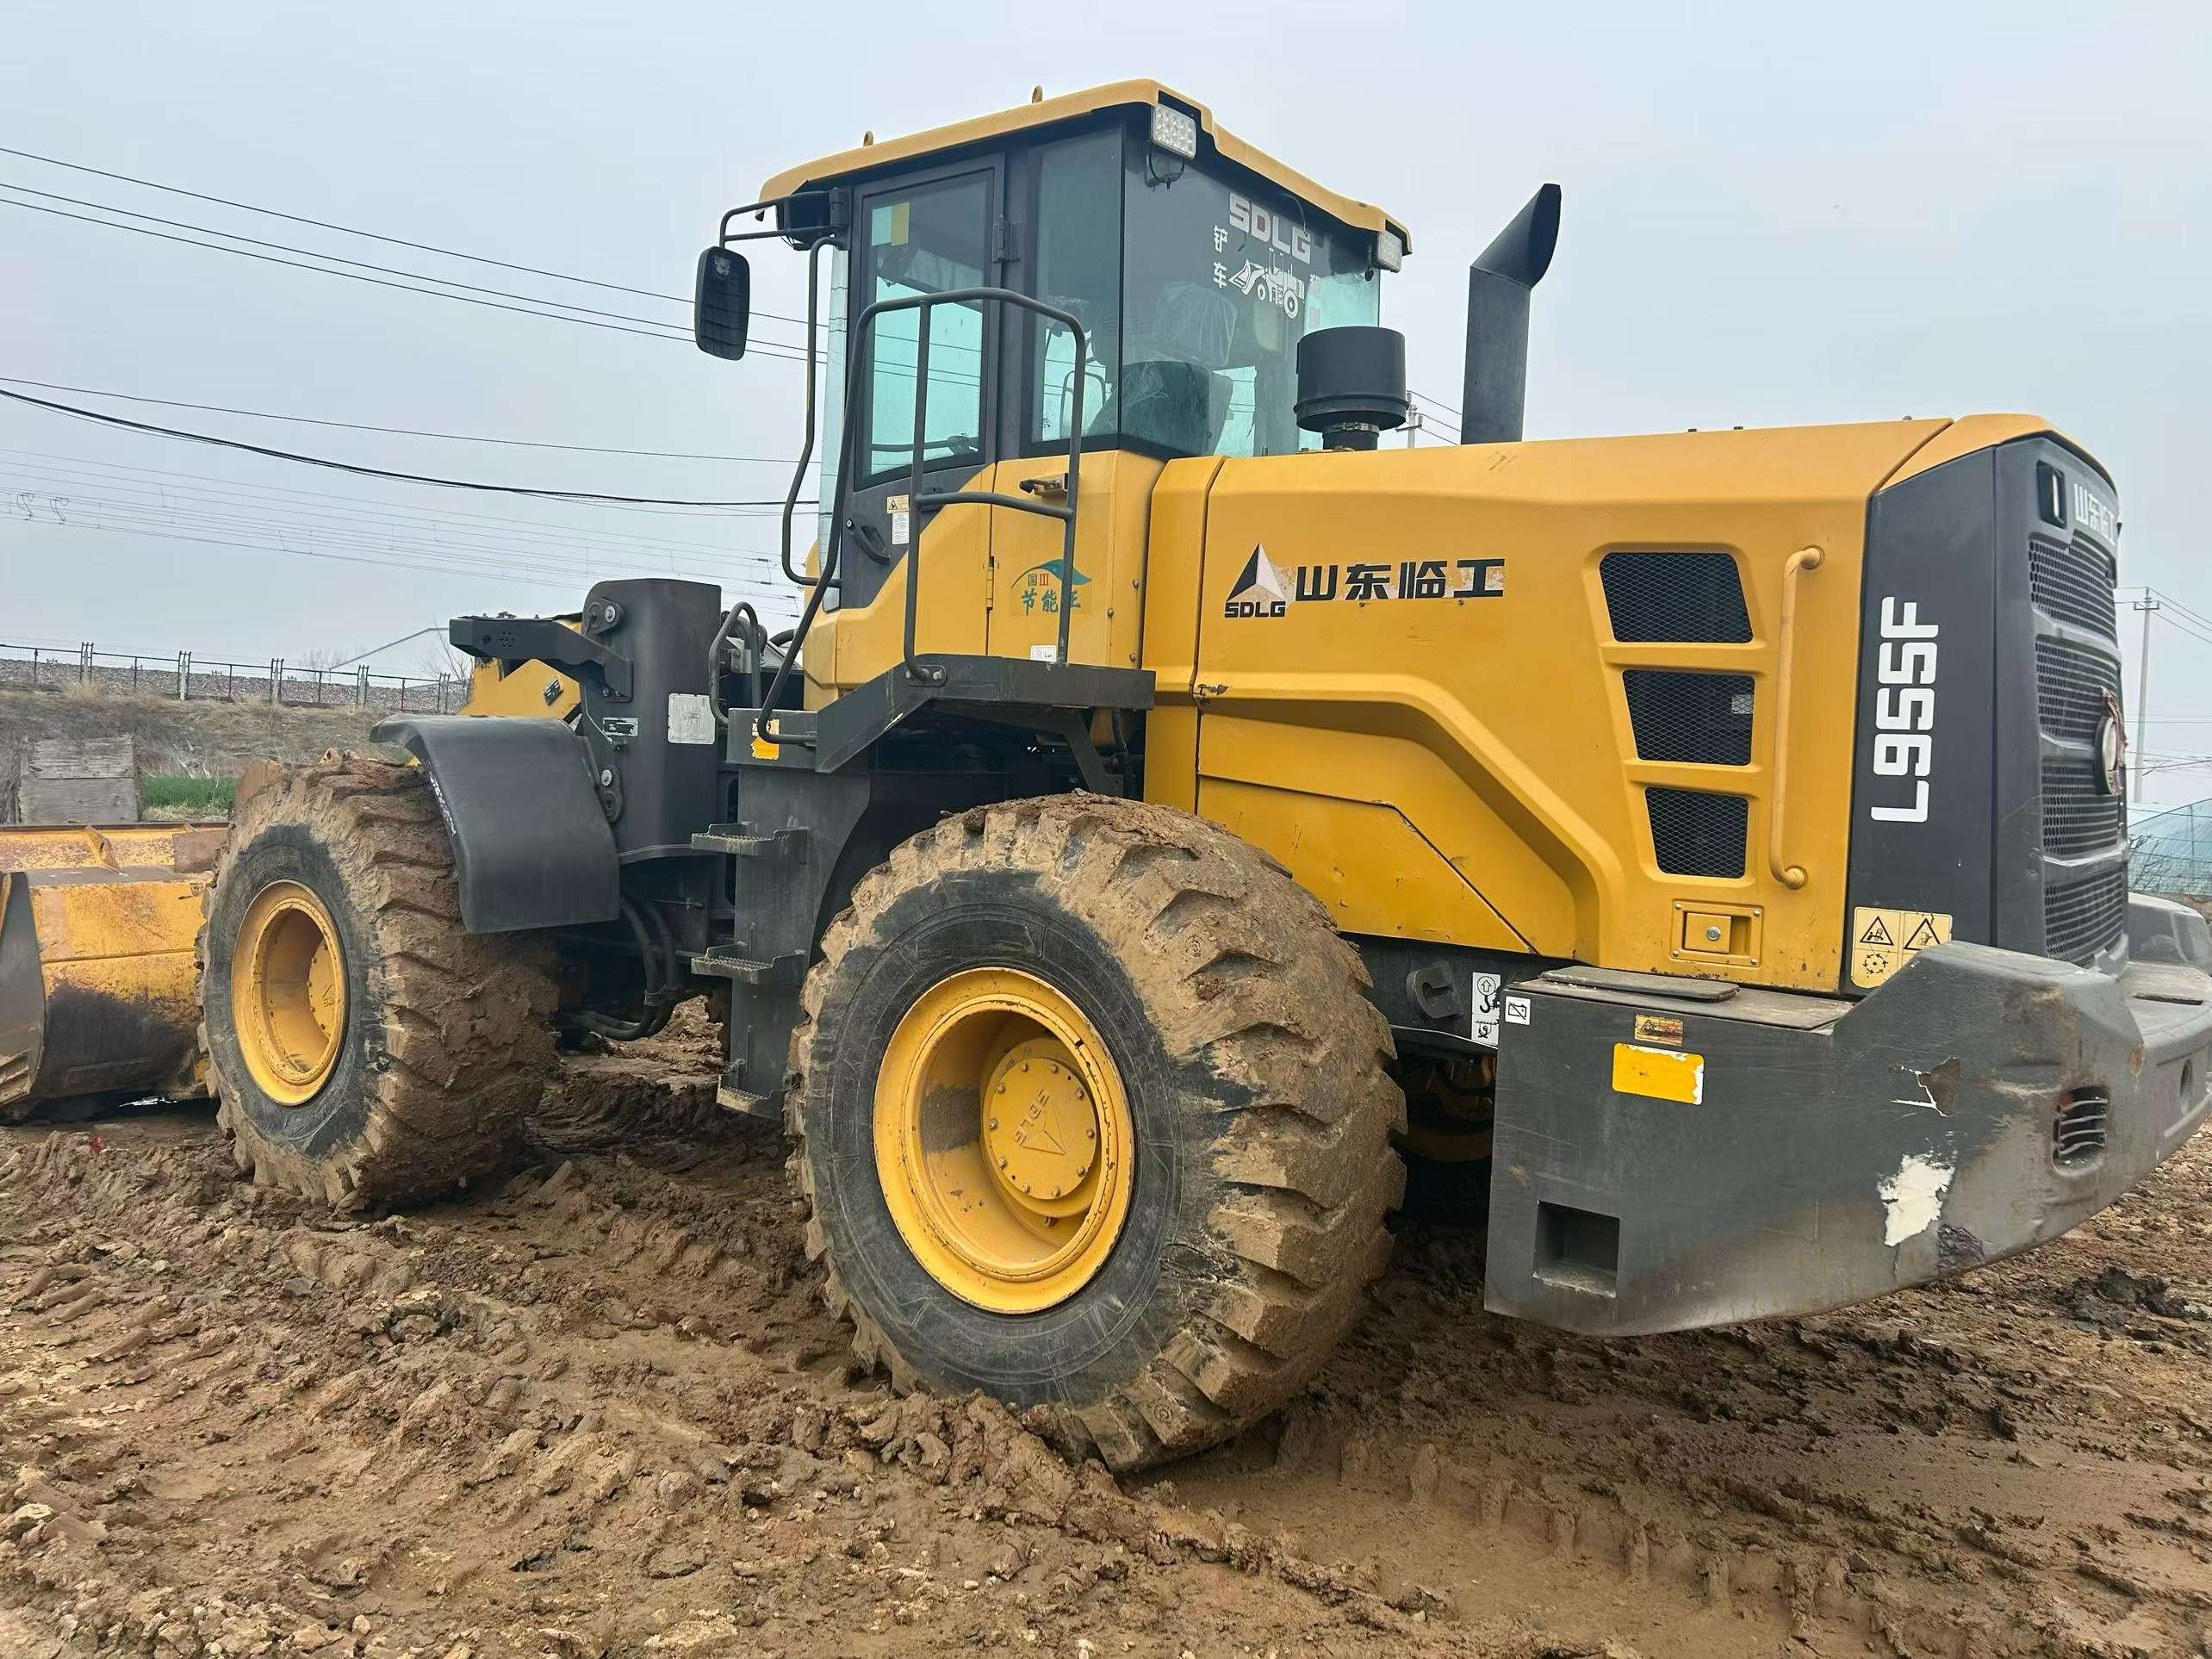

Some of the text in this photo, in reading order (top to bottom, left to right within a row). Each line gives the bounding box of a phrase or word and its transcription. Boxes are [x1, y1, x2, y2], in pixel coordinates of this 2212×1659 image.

[1229, 192, 1311, 264] SDLG
[1296, 558, 1505, 602] 山东临工
[1224, 601, 1286, 618] SDLG
[1871, 596, 1938, 823] L955F
